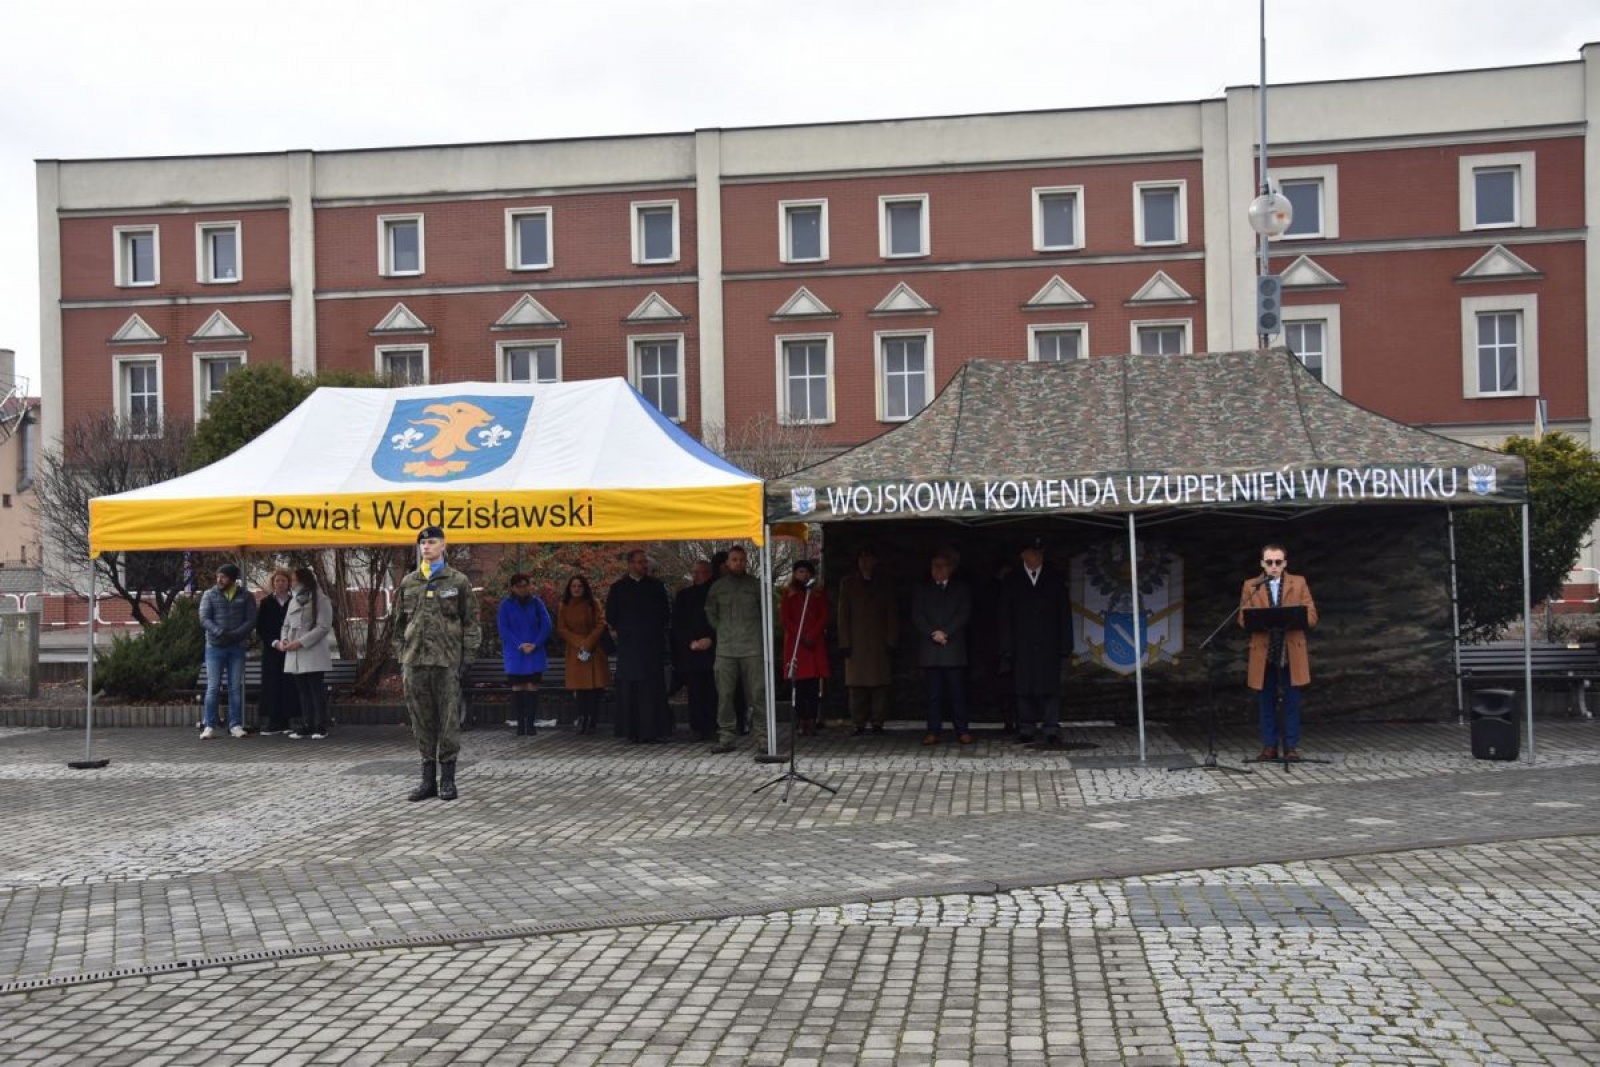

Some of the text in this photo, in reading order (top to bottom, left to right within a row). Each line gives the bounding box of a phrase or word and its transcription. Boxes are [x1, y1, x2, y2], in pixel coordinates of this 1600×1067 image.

[827, 481, 977, 515] WOJSKOWA
[984, 476, 1119, 509] KOMENDA
[1301, 469, 1329, 499] W
[1337, 467, 1457, 499] RYBNIKU
[252, 496, 594, 530] Powiat Wodzisławski
